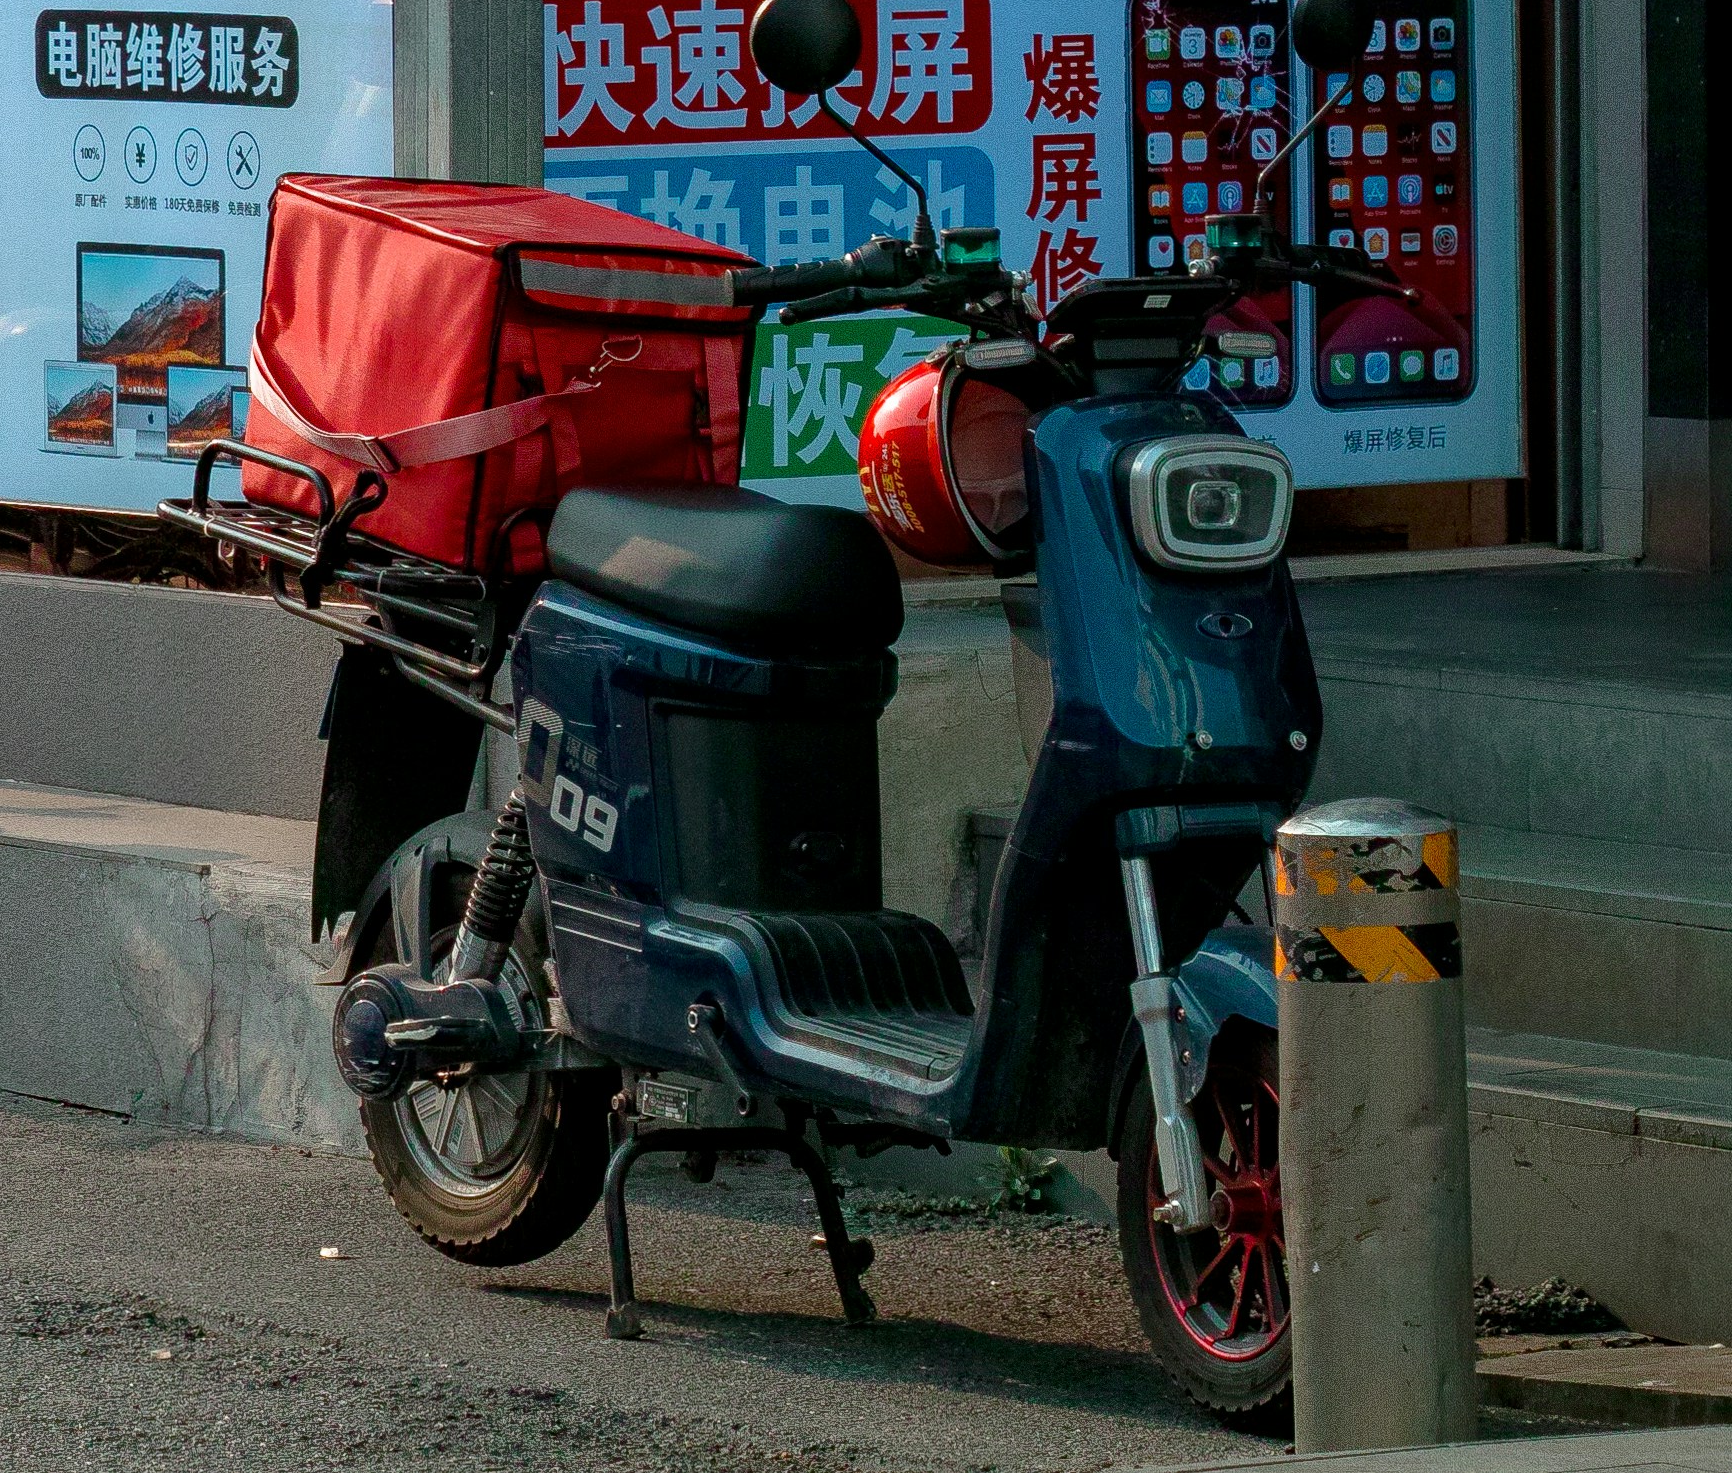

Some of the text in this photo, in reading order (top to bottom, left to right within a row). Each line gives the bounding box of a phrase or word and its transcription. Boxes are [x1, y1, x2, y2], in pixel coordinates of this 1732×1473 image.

[46, 20, 292, 99] 电脑维修服务
[80, 146, 101, 161] 100%
[1022, 32, 1105, 345] 爆屏修
[74, 193, 108, 209] 原厂配件
[124, 195, 158, 211] 实惠价格
[164, 196, 220, 215] 180天免费保修
[227, 200, 262, 218] 免费检测
[1343, 424, 1448, 455] 爆屏修复后
